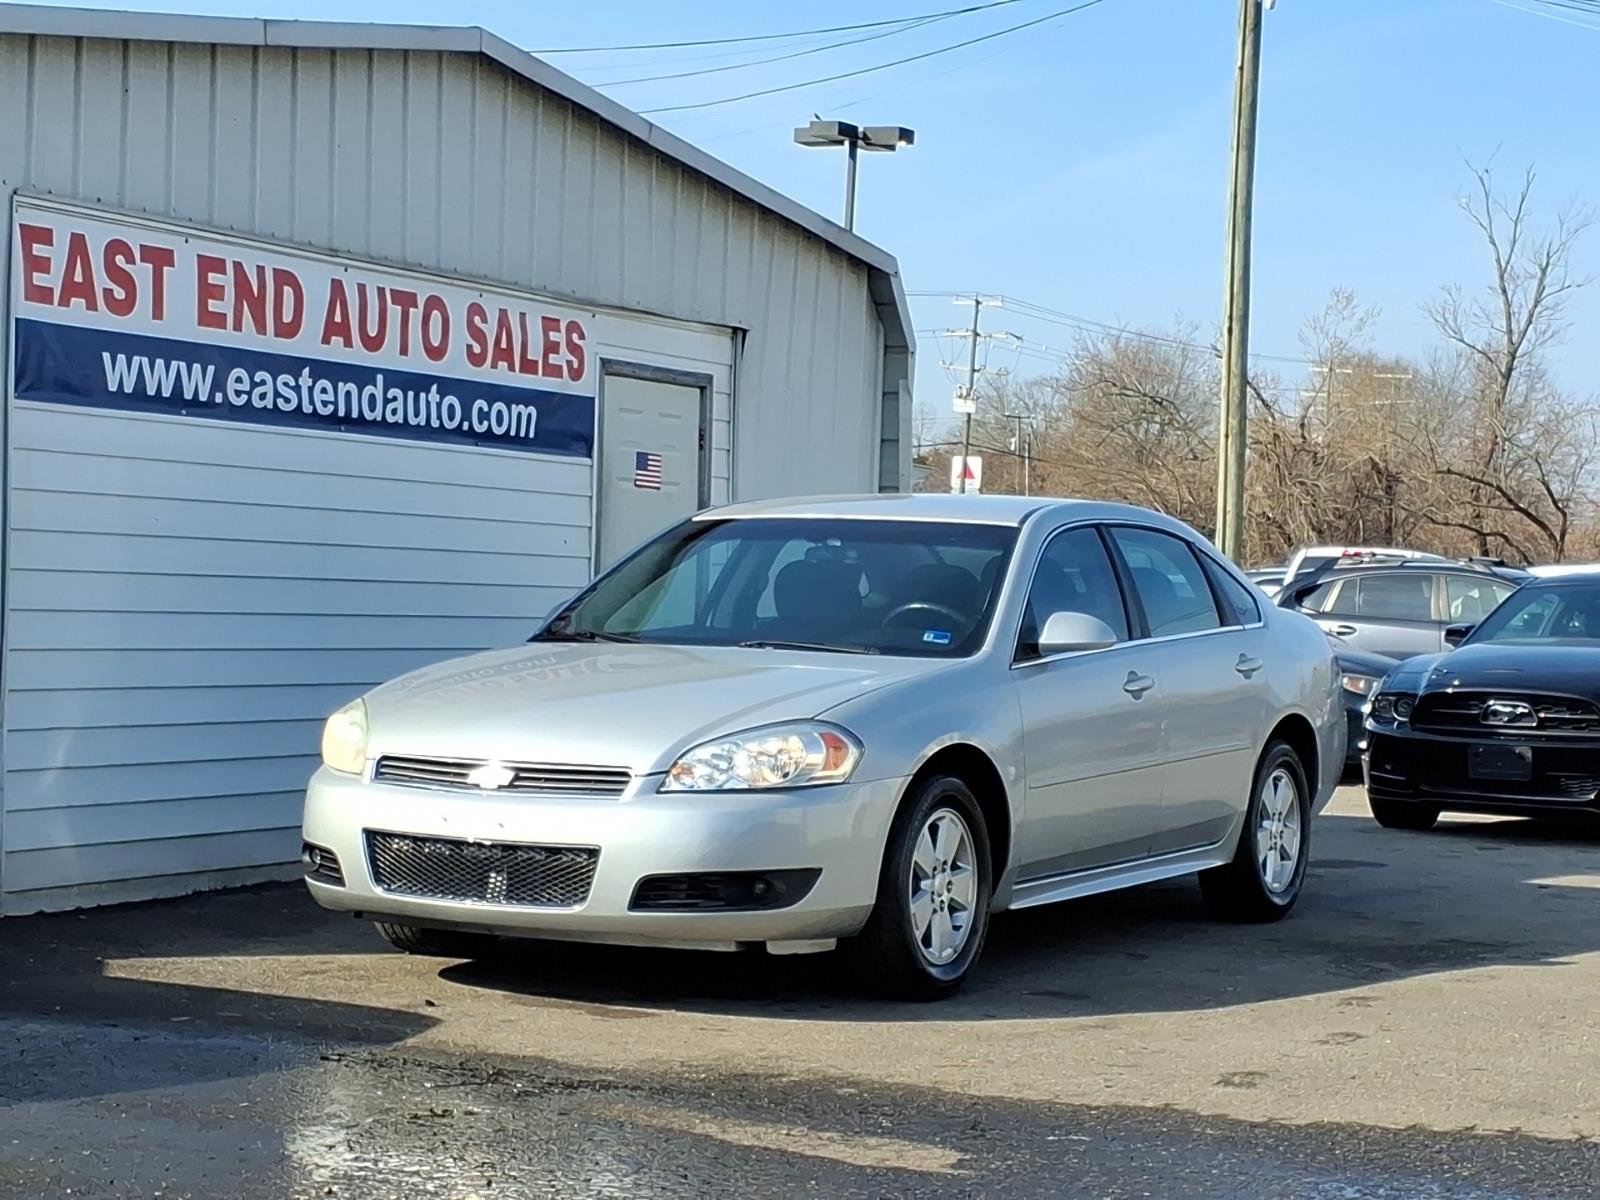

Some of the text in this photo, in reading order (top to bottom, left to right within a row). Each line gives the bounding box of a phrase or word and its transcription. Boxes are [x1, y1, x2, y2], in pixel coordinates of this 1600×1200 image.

[18, 222, 587, 382] EAST END AUTO SALES
[102, 350, 538, 438] www.eastendauto.com
